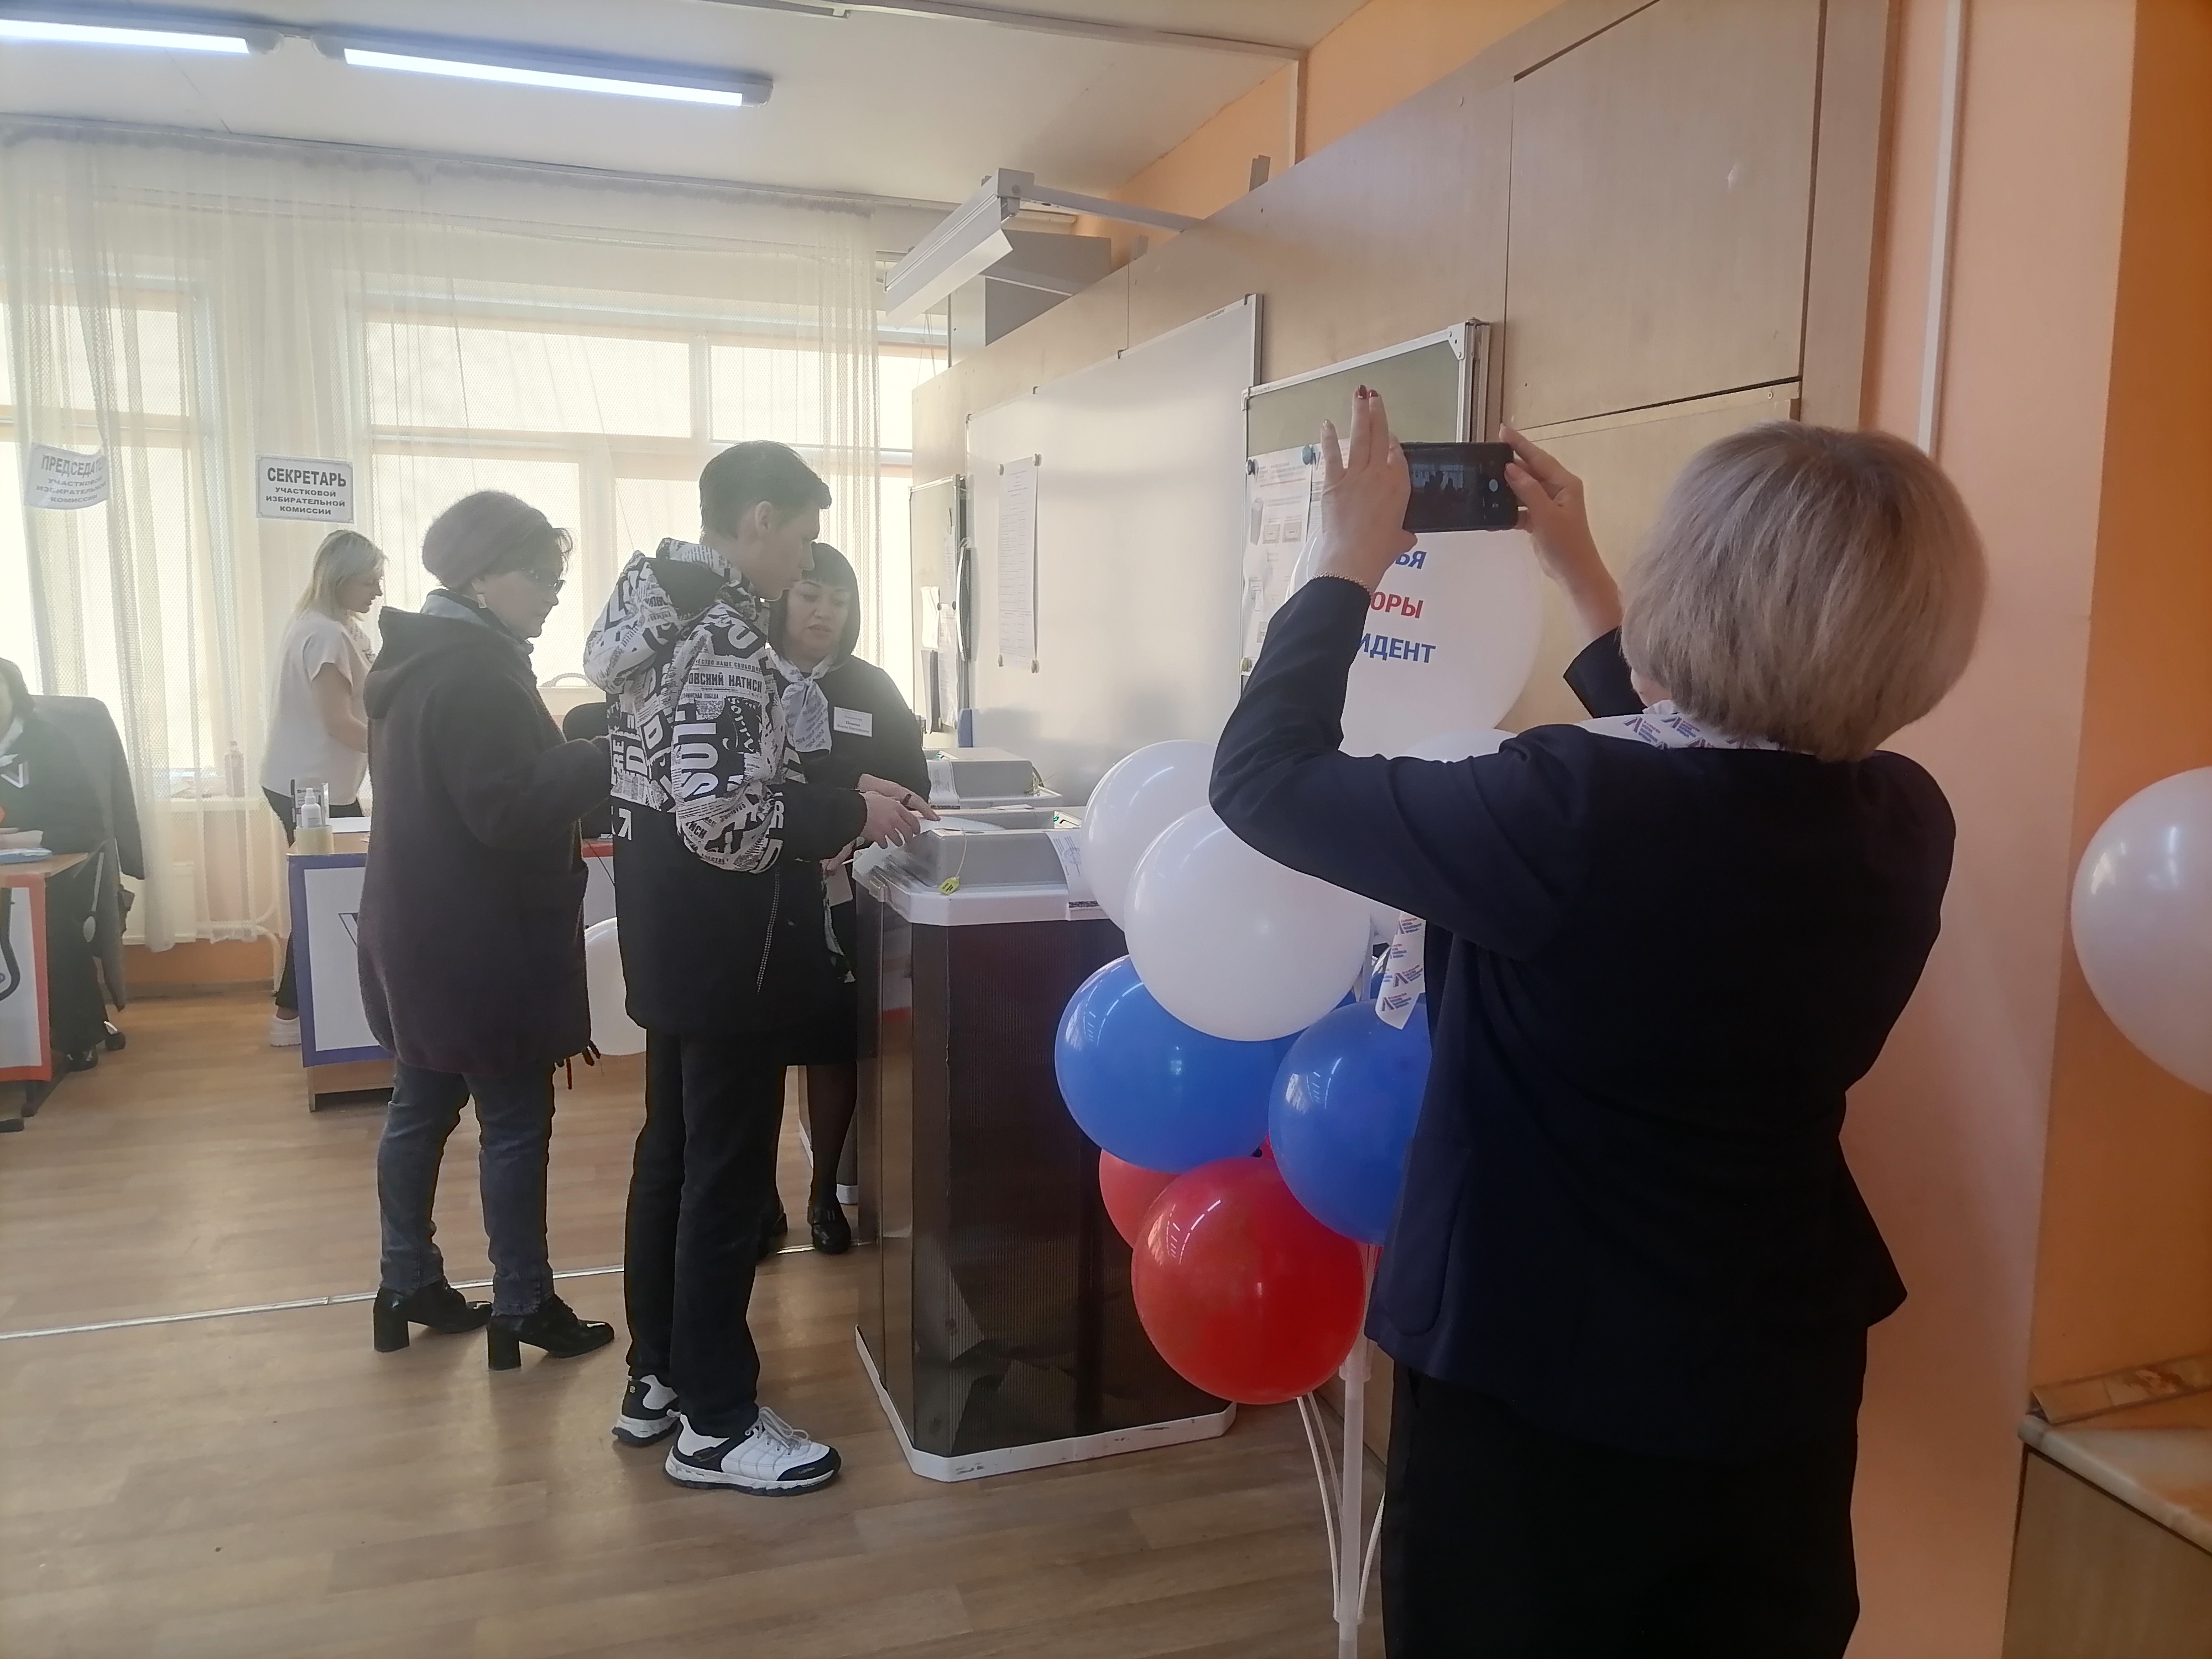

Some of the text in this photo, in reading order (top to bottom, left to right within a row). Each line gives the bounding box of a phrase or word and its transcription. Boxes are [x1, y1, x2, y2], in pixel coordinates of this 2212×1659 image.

[267, 467, 347, 487] СЕКРЕТАРЬ
[265, 495, 345, 507] ИЗБИРАТЕЛЬНОЙ
[275, 487, 336, 497] УЧАСТКОВОЙ
[280, 506, 331, 515] КОМИССИИ
[1395, 551, 1427, 570] ЬЯ
[1370, 591, 1424, 619] ОРЫ
[1360, 633, 1436, 664] ИДЕНТ
